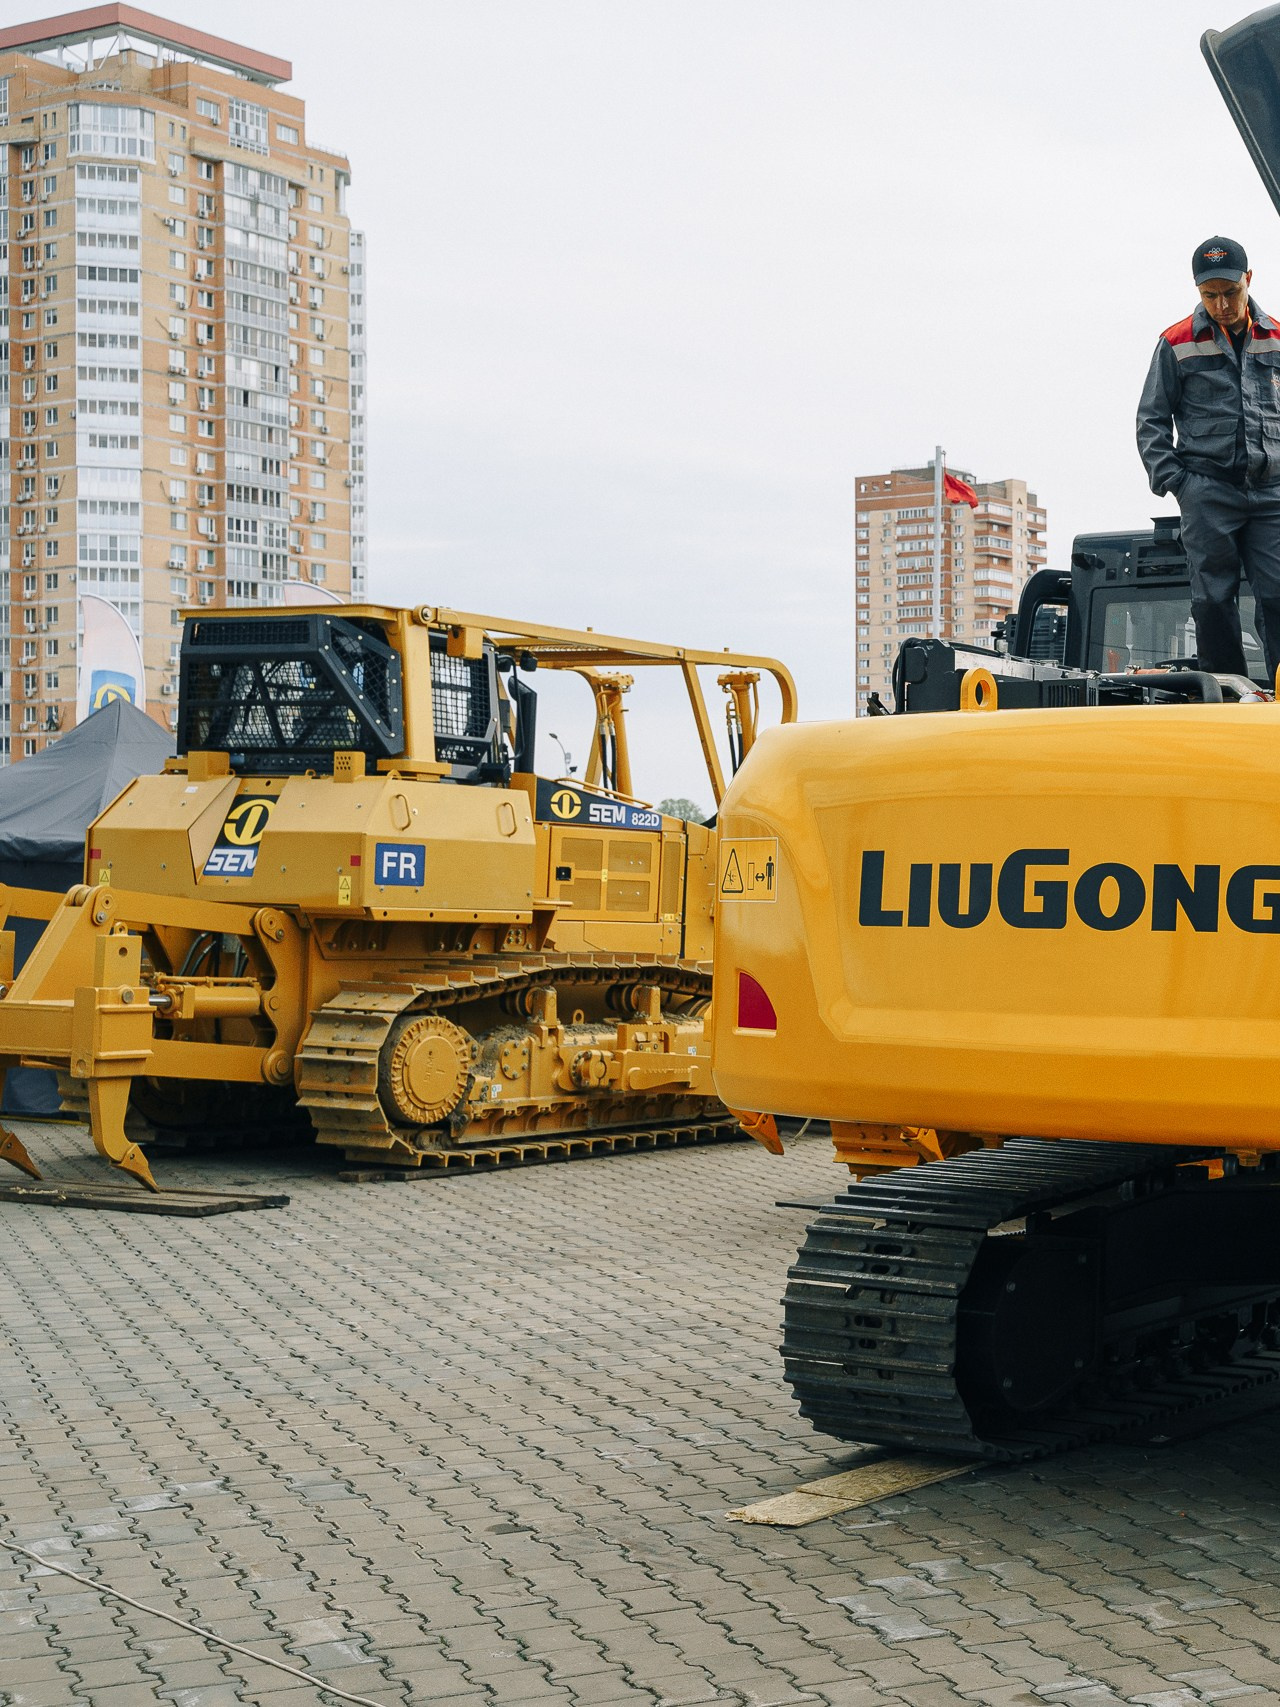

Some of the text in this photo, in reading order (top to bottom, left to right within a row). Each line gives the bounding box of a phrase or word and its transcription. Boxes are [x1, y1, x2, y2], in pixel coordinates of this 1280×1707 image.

[589, 803, 660, 827] SEM 822D
[382, 850, 417, 880] FR
